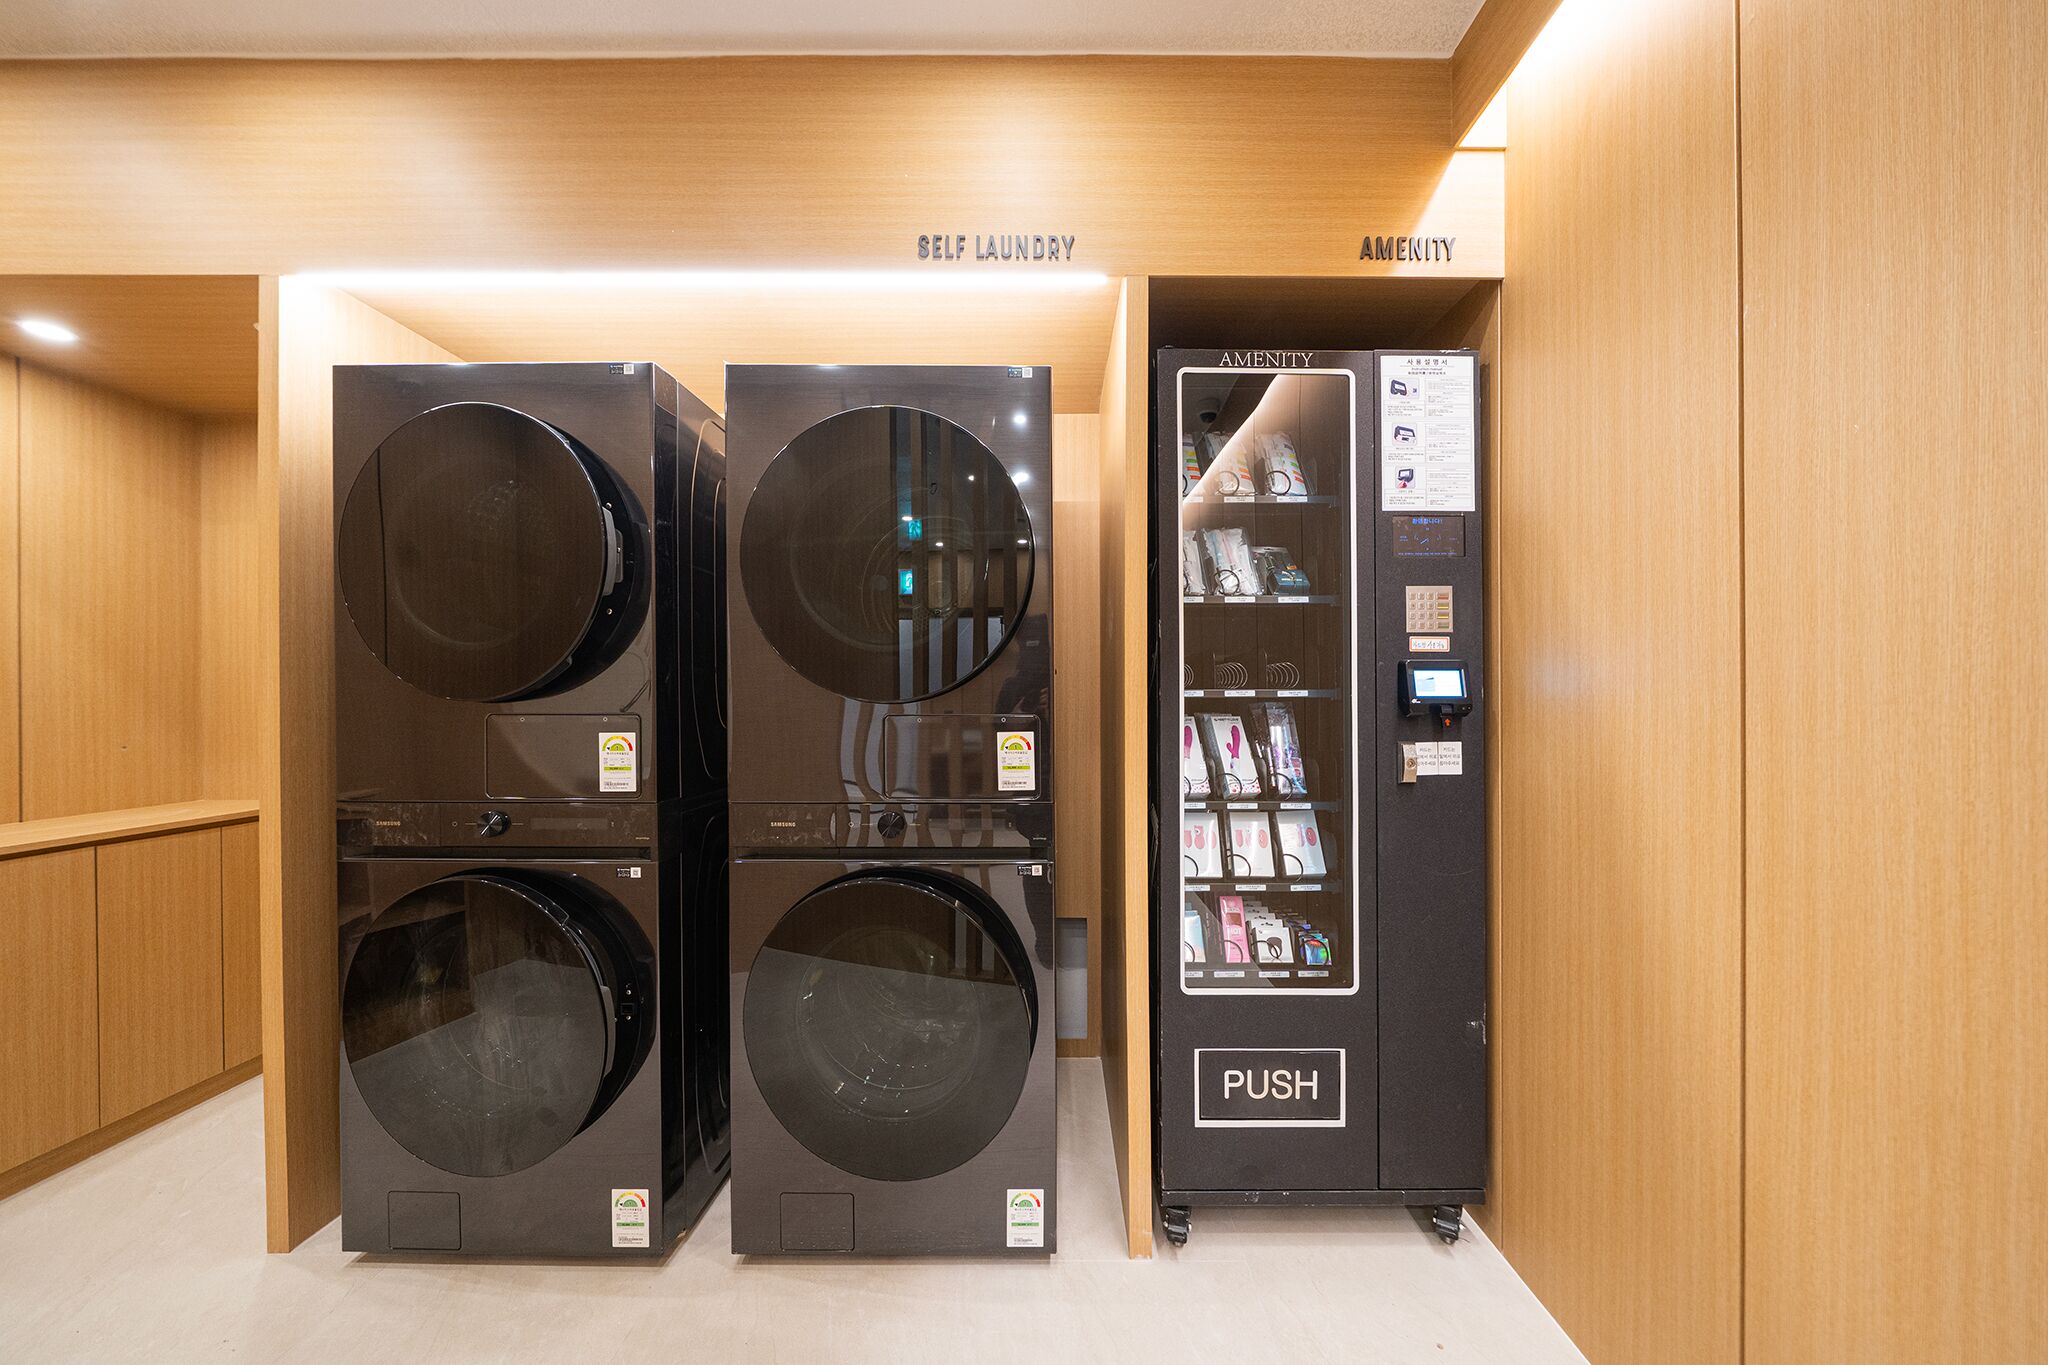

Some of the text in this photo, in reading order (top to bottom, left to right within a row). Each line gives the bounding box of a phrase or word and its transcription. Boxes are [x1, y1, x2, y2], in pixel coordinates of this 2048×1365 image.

[918, 234, 1075, 261] SELF LAUNDRY
[1360, 236, 1456, 262] AMENITY
[1219, 351, 1314, 368] AMENITY
[1223, 1069, 1318, 1100] PUSH
